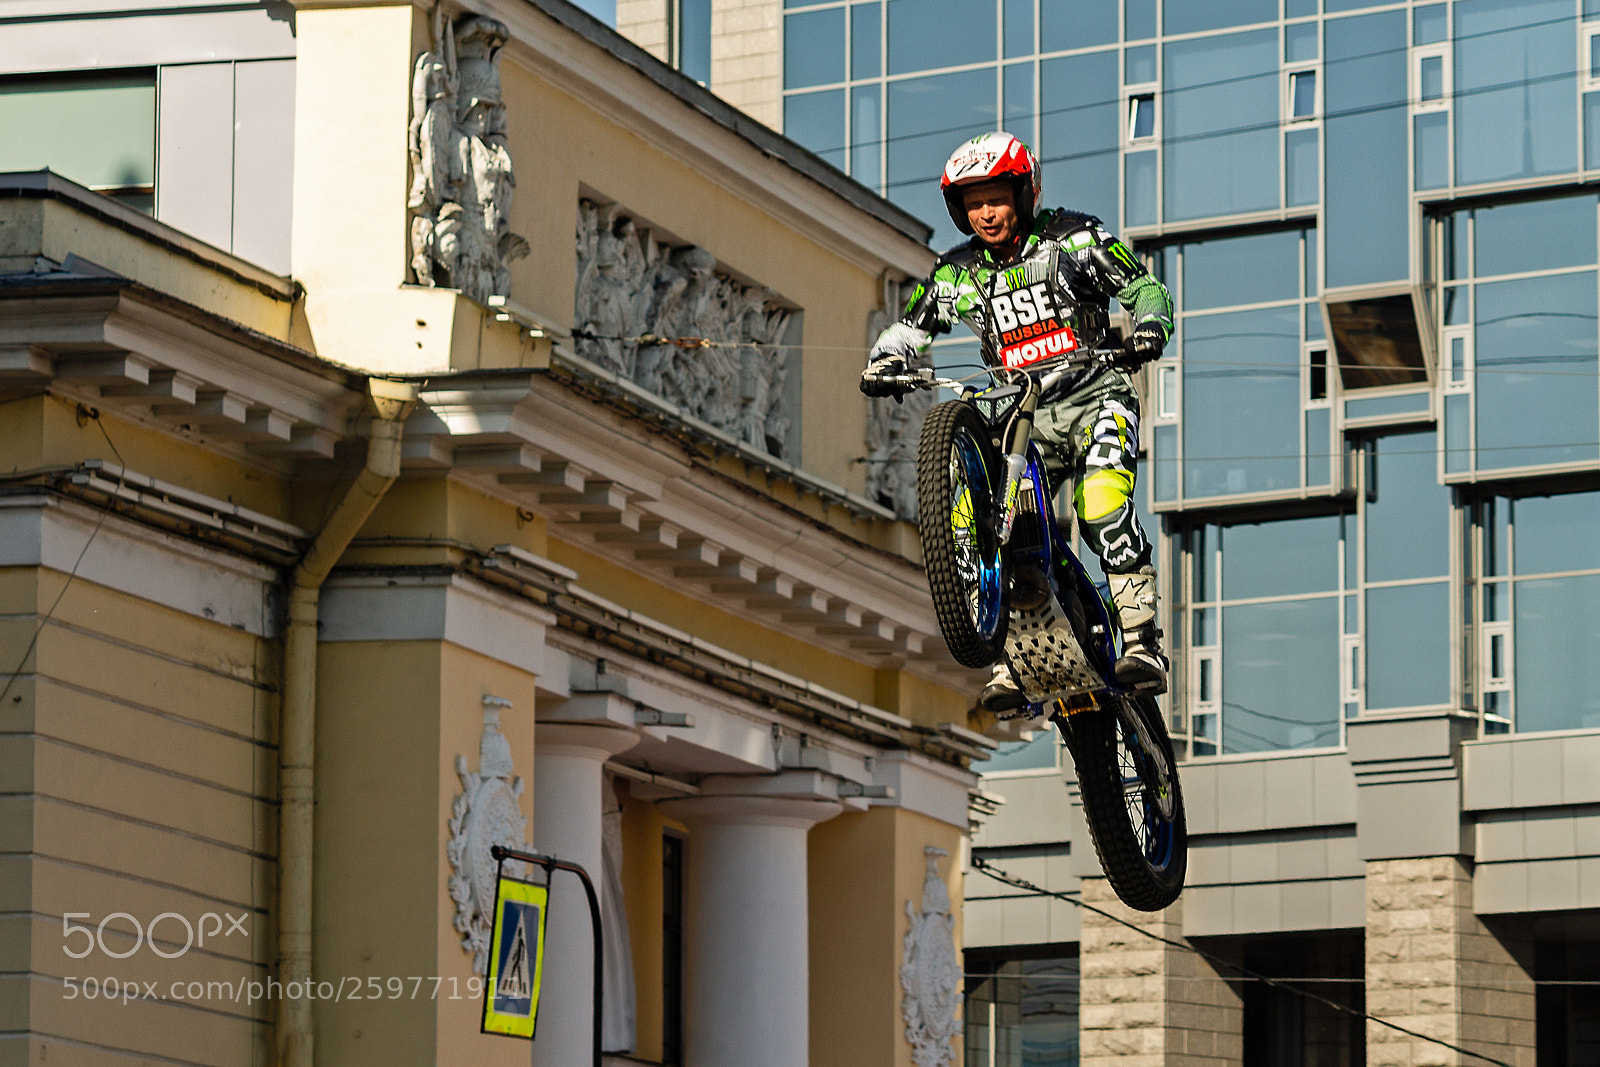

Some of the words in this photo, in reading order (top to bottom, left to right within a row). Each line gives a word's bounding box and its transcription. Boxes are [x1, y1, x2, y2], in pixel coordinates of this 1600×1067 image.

[991, 283, 1055, 333] BSE
[1002, 319, 1059, 345] RUSSIA
[1006, 331, 1073, 367] MOTUL
